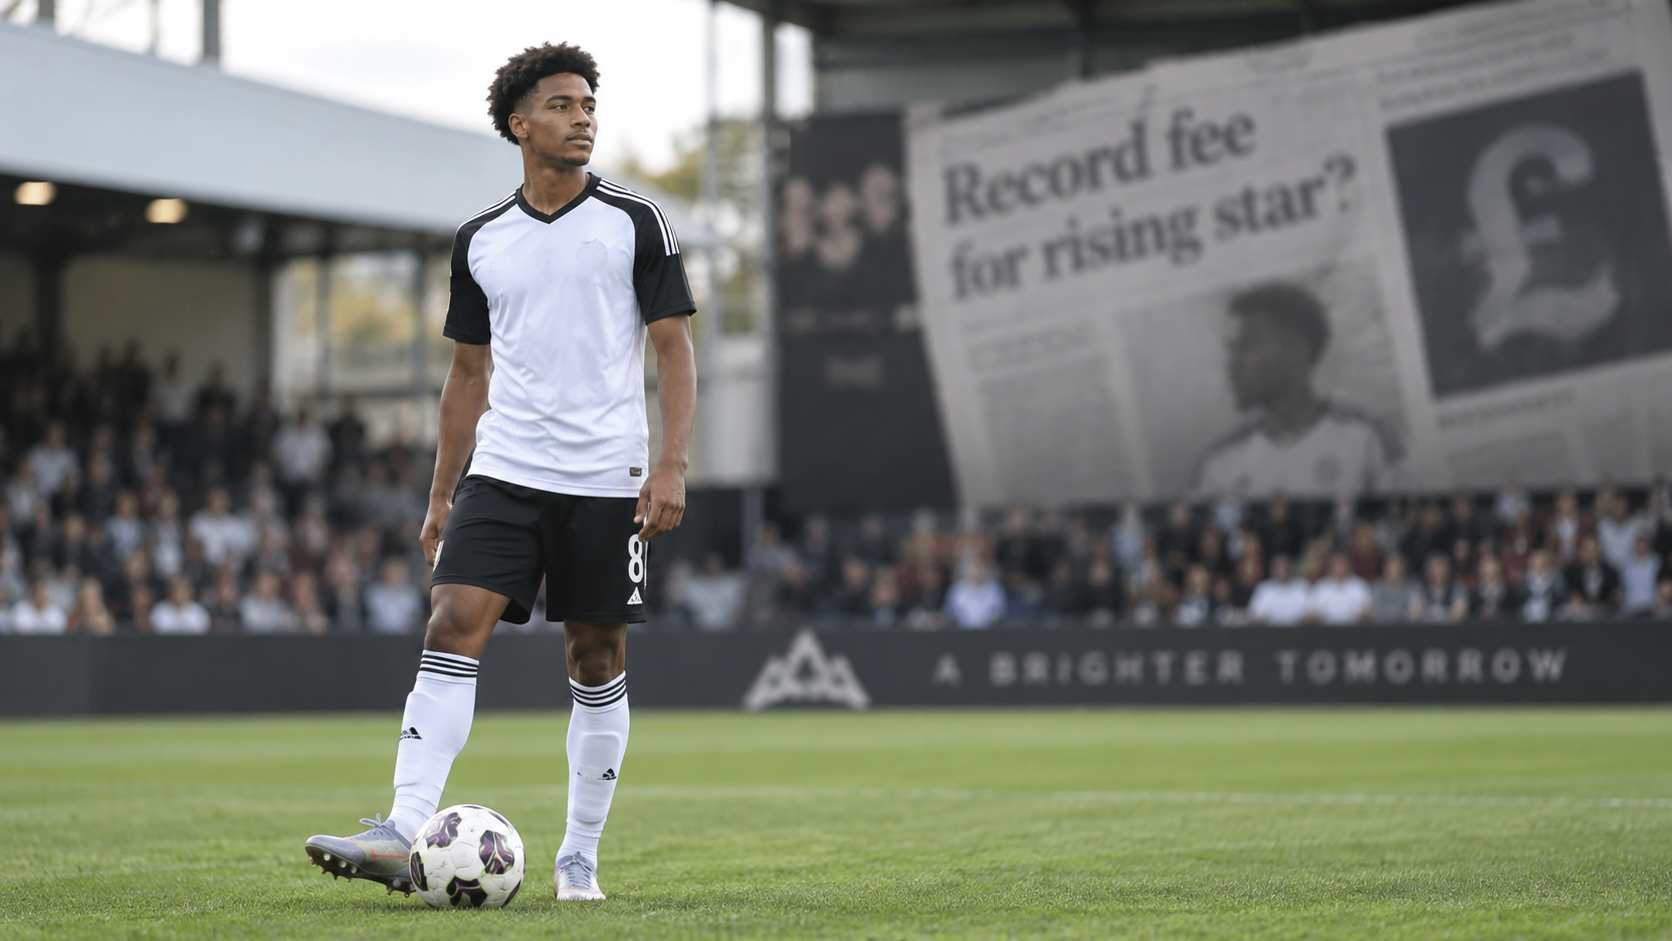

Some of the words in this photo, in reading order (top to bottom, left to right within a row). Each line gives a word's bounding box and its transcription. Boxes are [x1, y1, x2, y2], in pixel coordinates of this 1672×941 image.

[942, 118, 1153, 227] Record
[1166, 106, 1258, 173] fee
[949, 239, 1029, 301] for
[1041, 205, 1205, 268] rising
[1213, 153, 1358, 242] star?
[1459, 121, 1621, 352] £
[628, 533, 644, 584] 8
[931, 652, 964, 687] A
[988, 649, 1245, 687] BRIGHTER
[1272, 647, 1568, 686] TOMORROW
